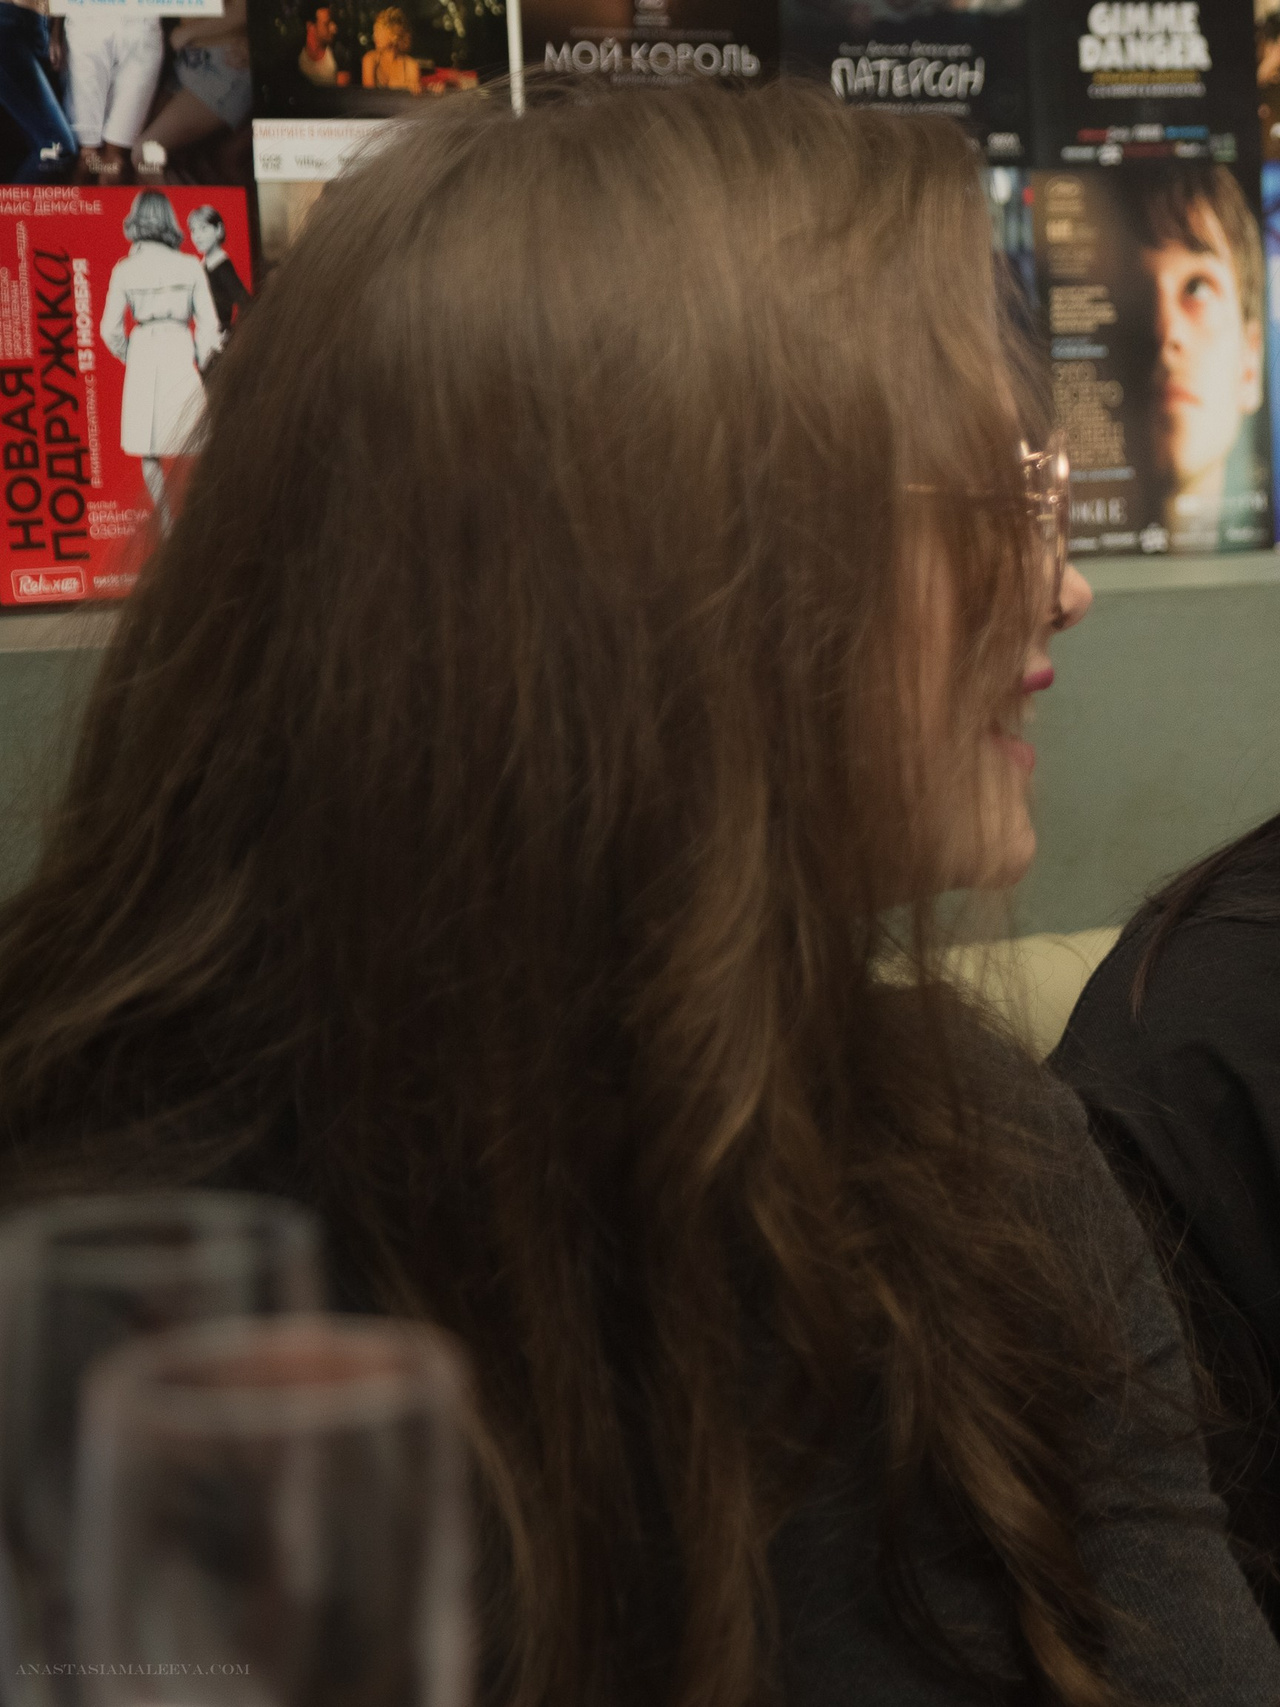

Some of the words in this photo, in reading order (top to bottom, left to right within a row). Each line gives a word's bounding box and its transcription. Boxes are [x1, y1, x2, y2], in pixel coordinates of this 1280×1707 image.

[1087, 2, 1200, 34] GIMME
[545, 37, 622, 74] МОЙ
[631, 42, 760, 77] КОРОЛЬ
[1078, 34, 1212, 71] DANGER
[831, 56, 985, 99] ПАТЕРСОН
[33, 186, 81, 200] ДЮРИС
[34, 200, 103, 215] ДЕМУСТЬЕ
[72, 258, 94, 347] НОЯБРЯ
[0, 366, 46, 550] НОВАЯ
[88, 509, 150, 525] ФРАНСУА
